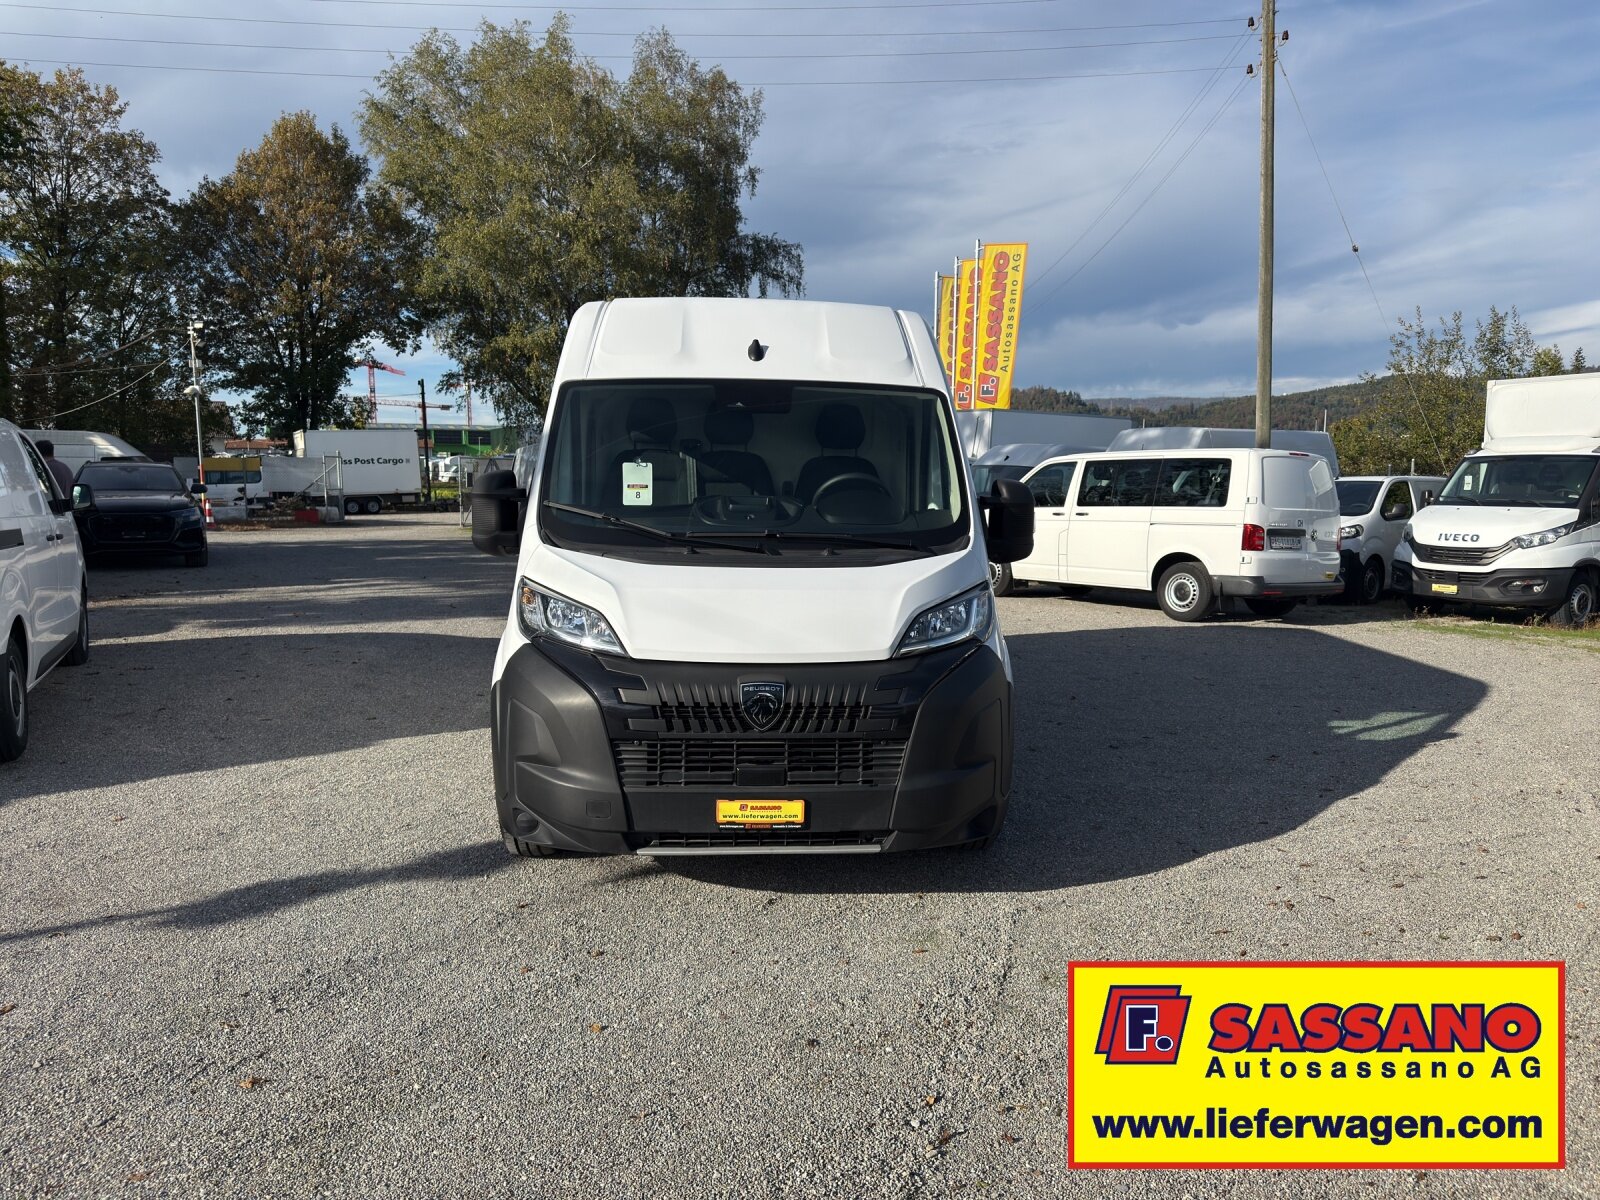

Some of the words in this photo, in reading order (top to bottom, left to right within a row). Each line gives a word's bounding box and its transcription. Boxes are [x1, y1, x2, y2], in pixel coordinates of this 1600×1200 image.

[983, 251, 1010, 373] SASSANO
[1000, 279, 1019, 373] Autosassano
[1012, 253, 1022, 272] AG
[354, 457, 375, 465] Post
[376, 457, 404, 466] Cargo
[635, 491, 641, 499] 8
[1438, 533, 1480, 543] IVECO
